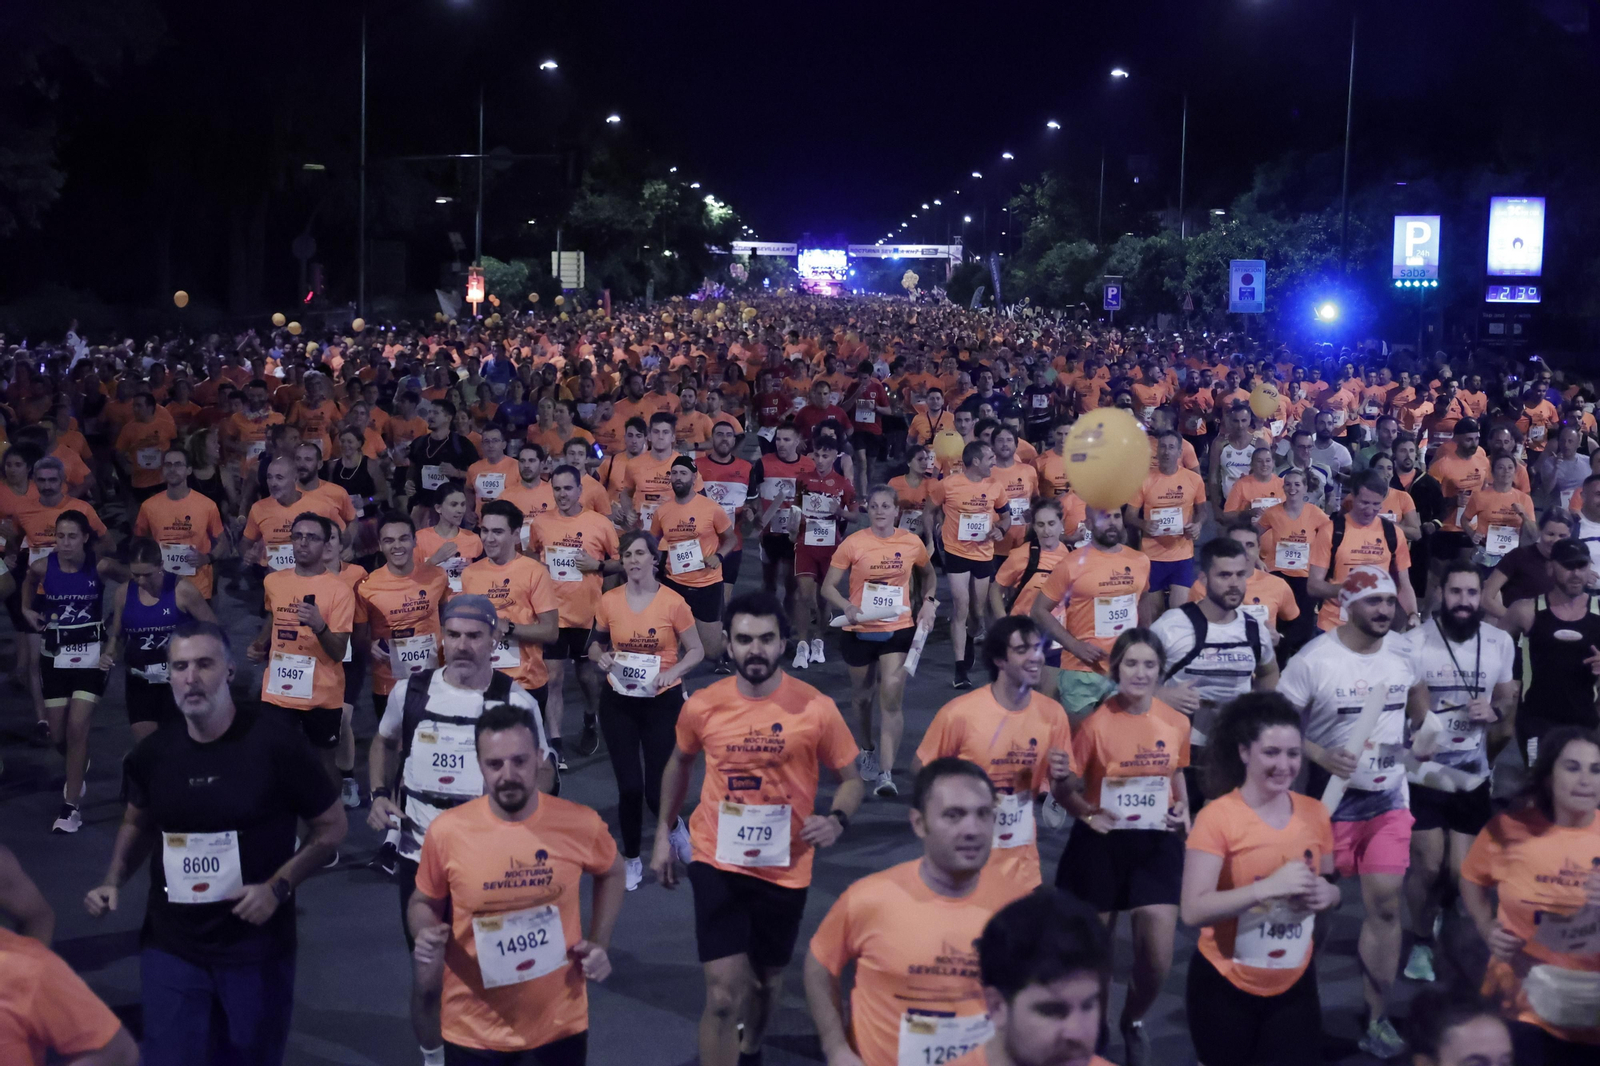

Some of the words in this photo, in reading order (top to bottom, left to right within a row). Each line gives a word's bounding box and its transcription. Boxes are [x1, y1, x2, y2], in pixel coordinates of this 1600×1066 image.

[1405, 221, 1431, 257] P
[1400, 268, 1426, 278] saba
[1107, 286, 1118, 299] P
[966, 522, 985, 530] 10021
[1496, 534, 1512, 543] 7206
[676, 550, 694, 561] 8681
[552, 557, 575, 567] 16443
[873, 596, 894, 607] 5919
[1108, 609, 1129, 620] 3550
[401, 649, 431, 662] 20647
[277, 667, 304, 680] 15497
[622, 667, 647, 679] 6282
[432, 752, 465, 769] 2831
[1116, 794, 1156, 807] 13346
[737, 826, 773, 841] 4779
[183, 856, 220, 874] 8600
[504, 867, 554, 878] NOCTURNA
[483, 879, 527, 890] SEVILLA
[496, 928, 549, 956] 14982
